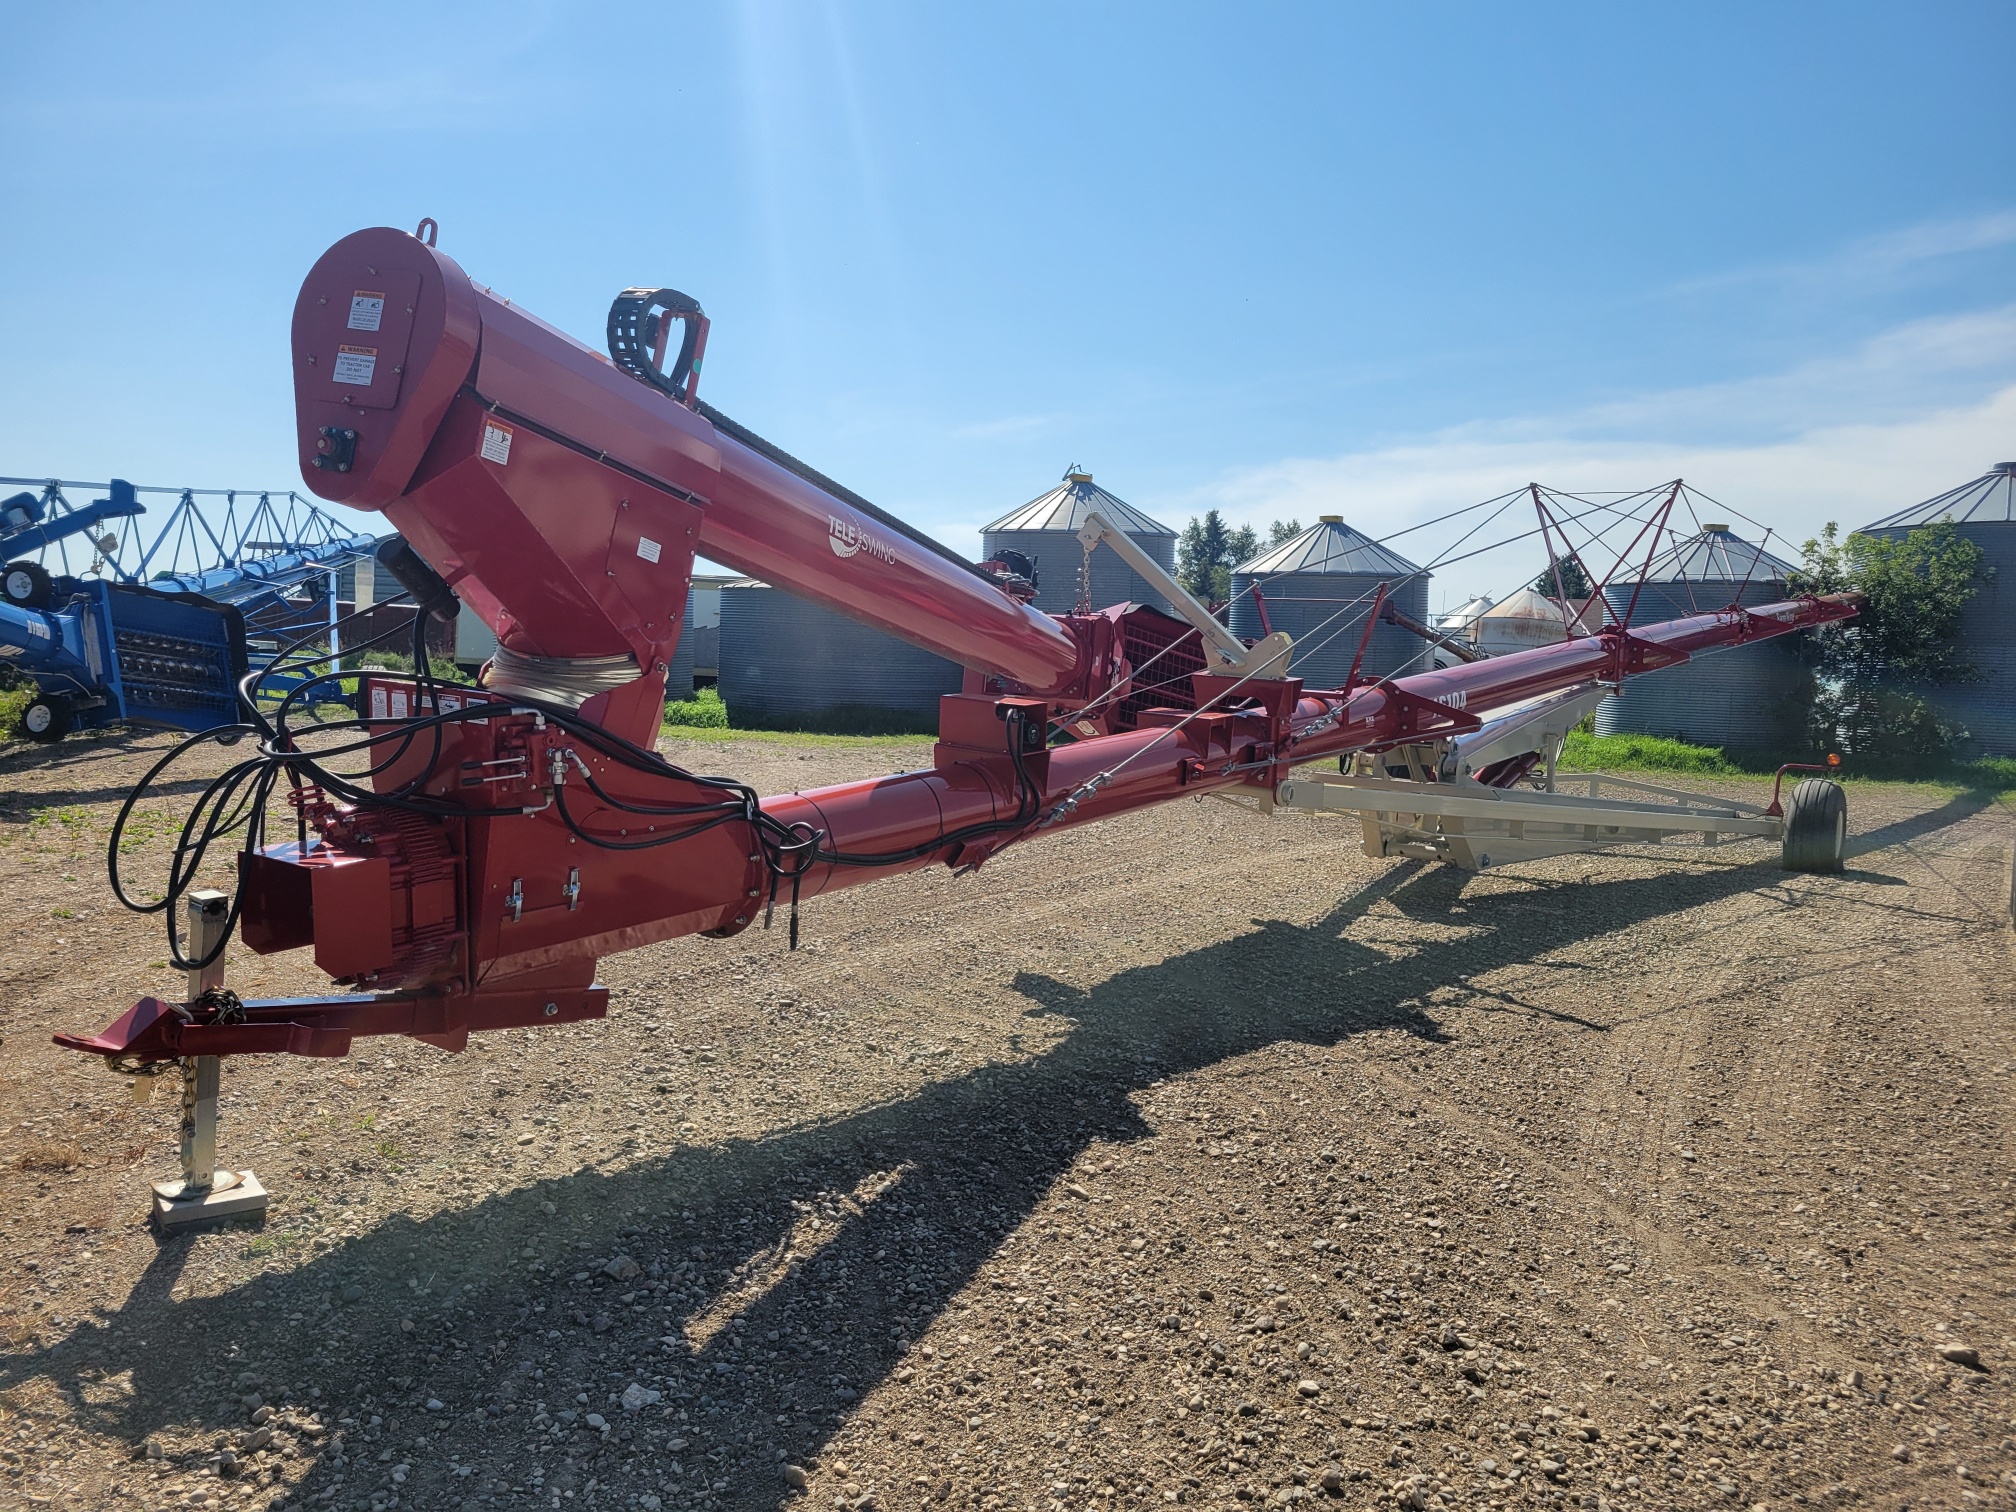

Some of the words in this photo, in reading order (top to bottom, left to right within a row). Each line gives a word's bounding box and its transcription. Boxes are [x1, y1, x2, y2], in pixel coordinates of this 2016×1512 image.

[347, 346, 374, 354] WARNING
[829, 514, 856, 545] TELE
[861, 533, 896, 565] SWING
